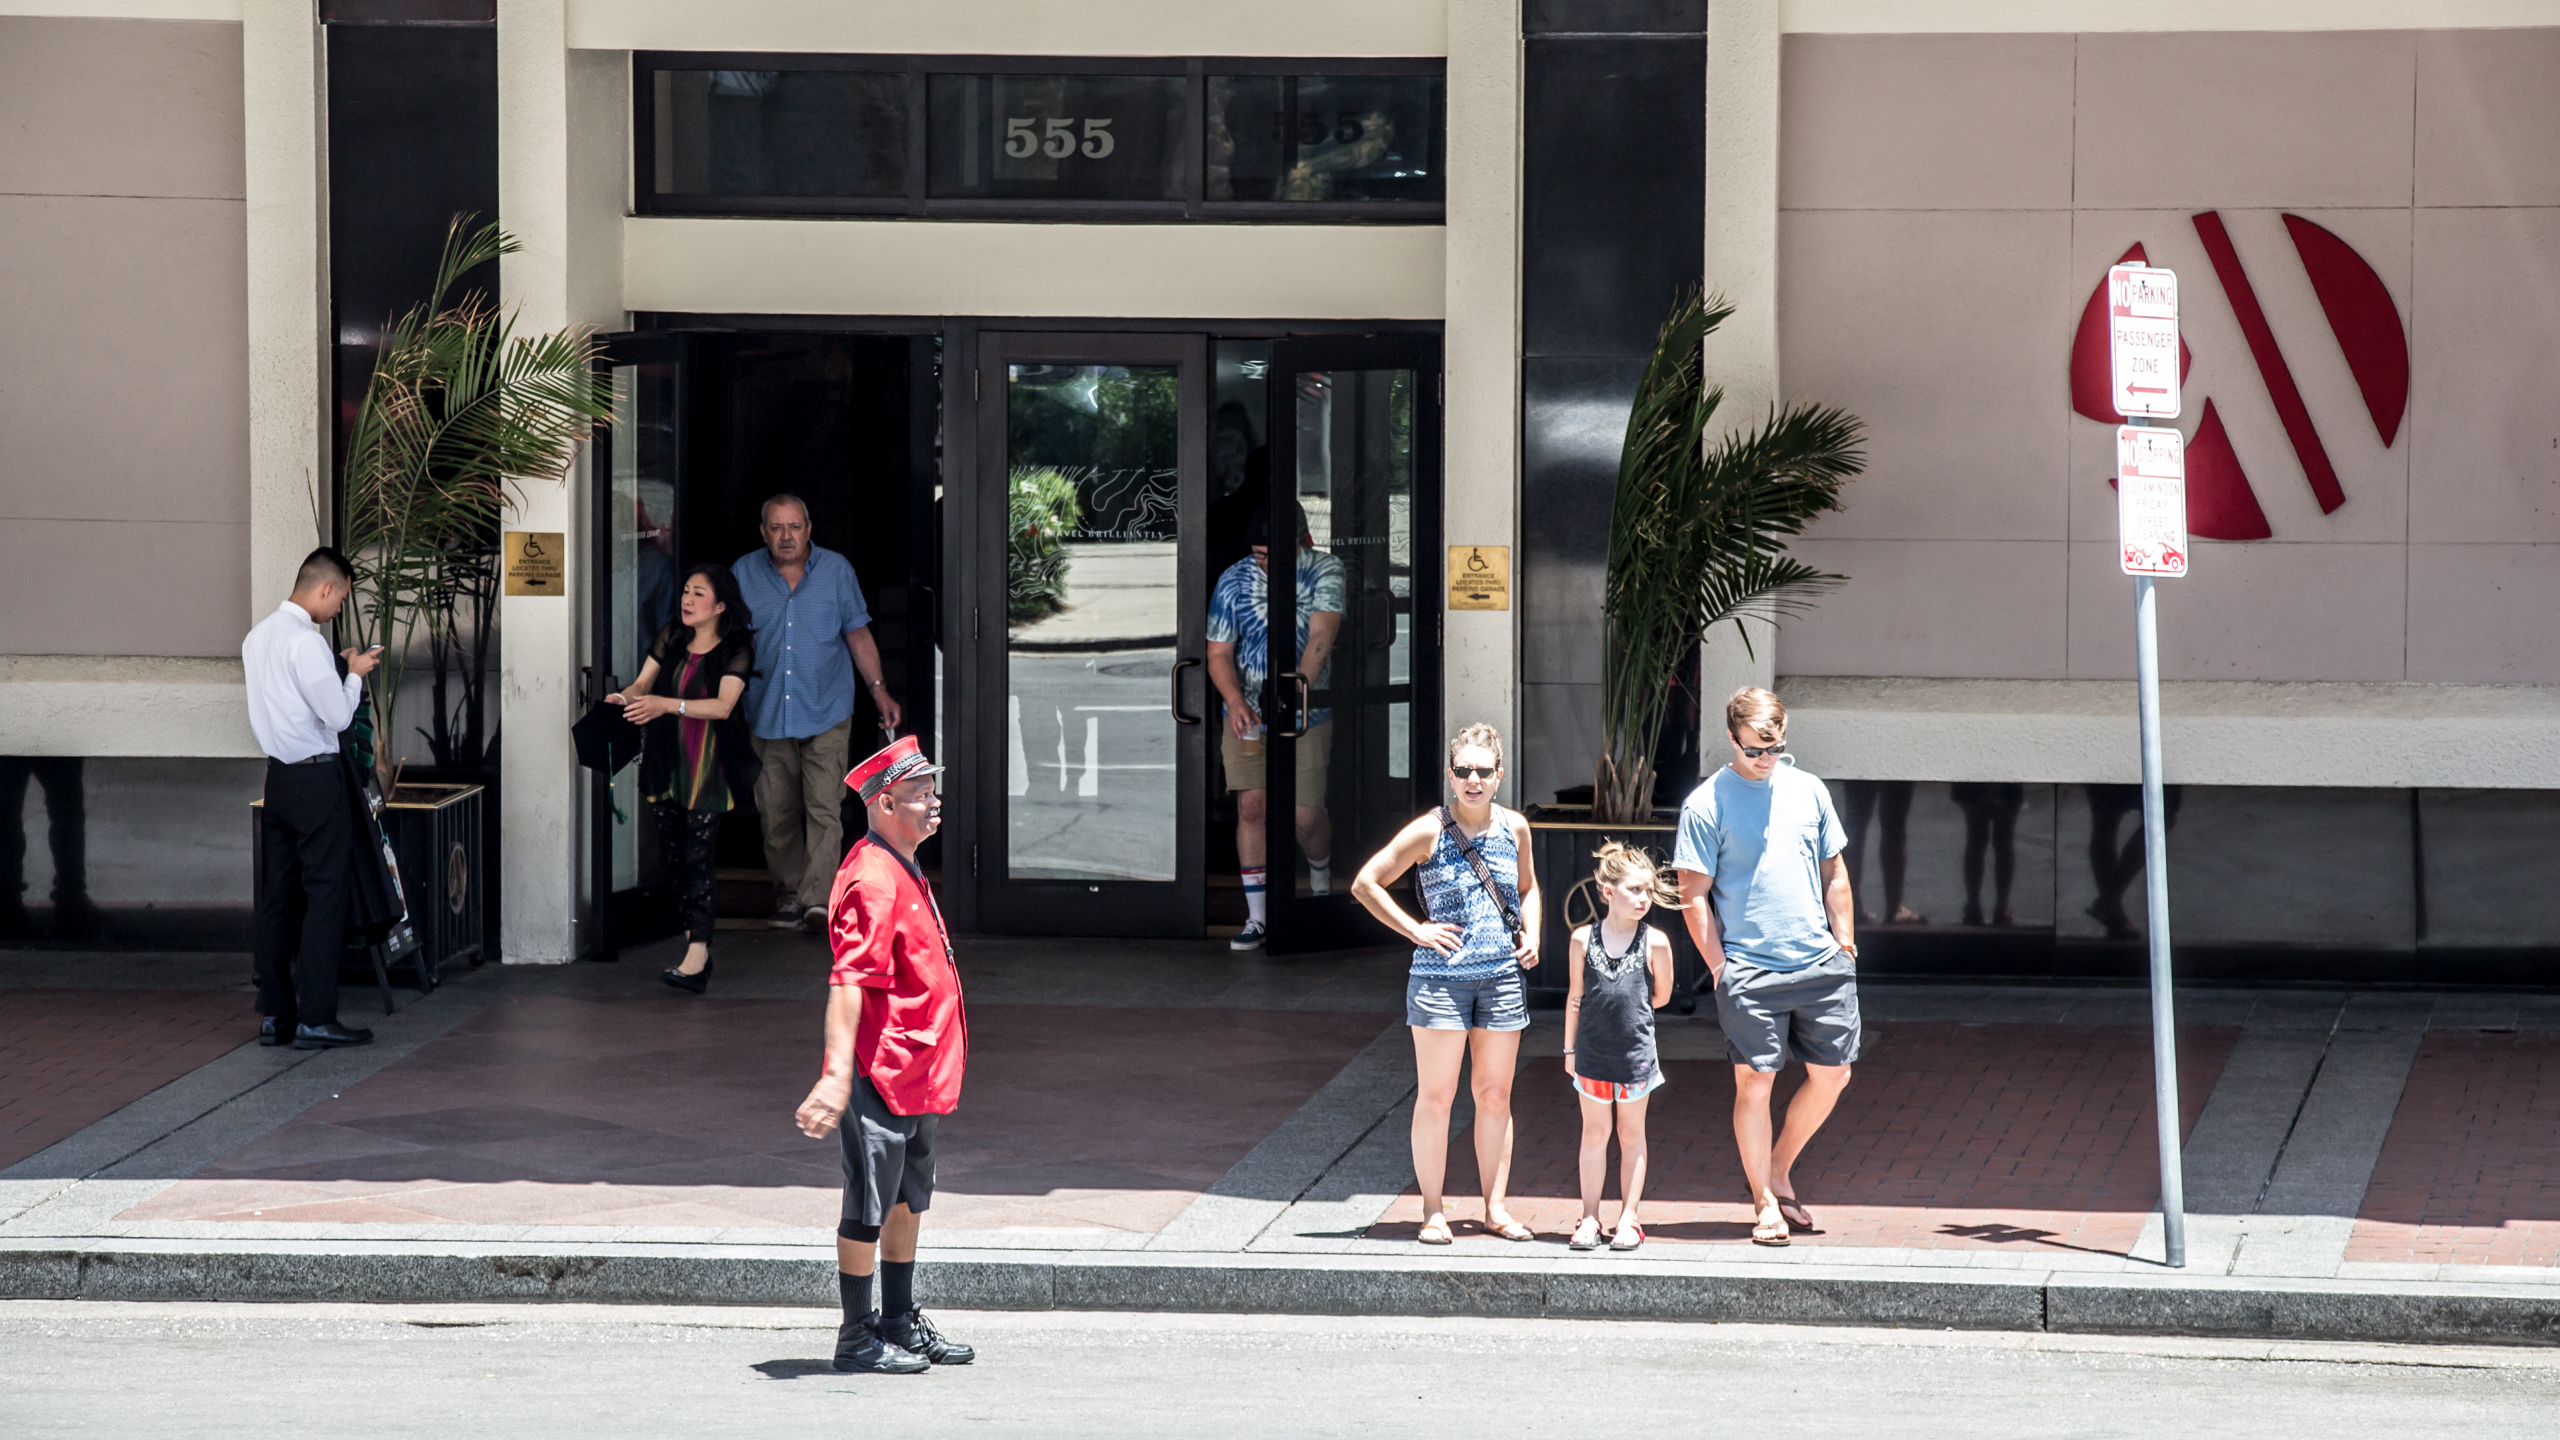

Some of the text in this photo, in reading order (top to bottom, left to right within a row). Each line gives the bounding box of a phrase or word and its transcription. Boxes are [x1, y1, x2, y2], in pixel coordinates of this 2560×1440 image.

[1005, 118, 1114, 158] 555
[2113, 280, 2173, 307] NO PARKING
[2117, 330, 2172, 348] PASSENGER
[2132, 357, 2159, 373] ZONE
[2121, 439, 2180, 467] NO STOPPING
[2136, 498, 2168, 511] FRIDAY
[2137, 515, 2168, 528] STREET
[1088, 530, 1163, 539] BRILLIANTLY
[2131, 528, 2176, 542] CLEANING
